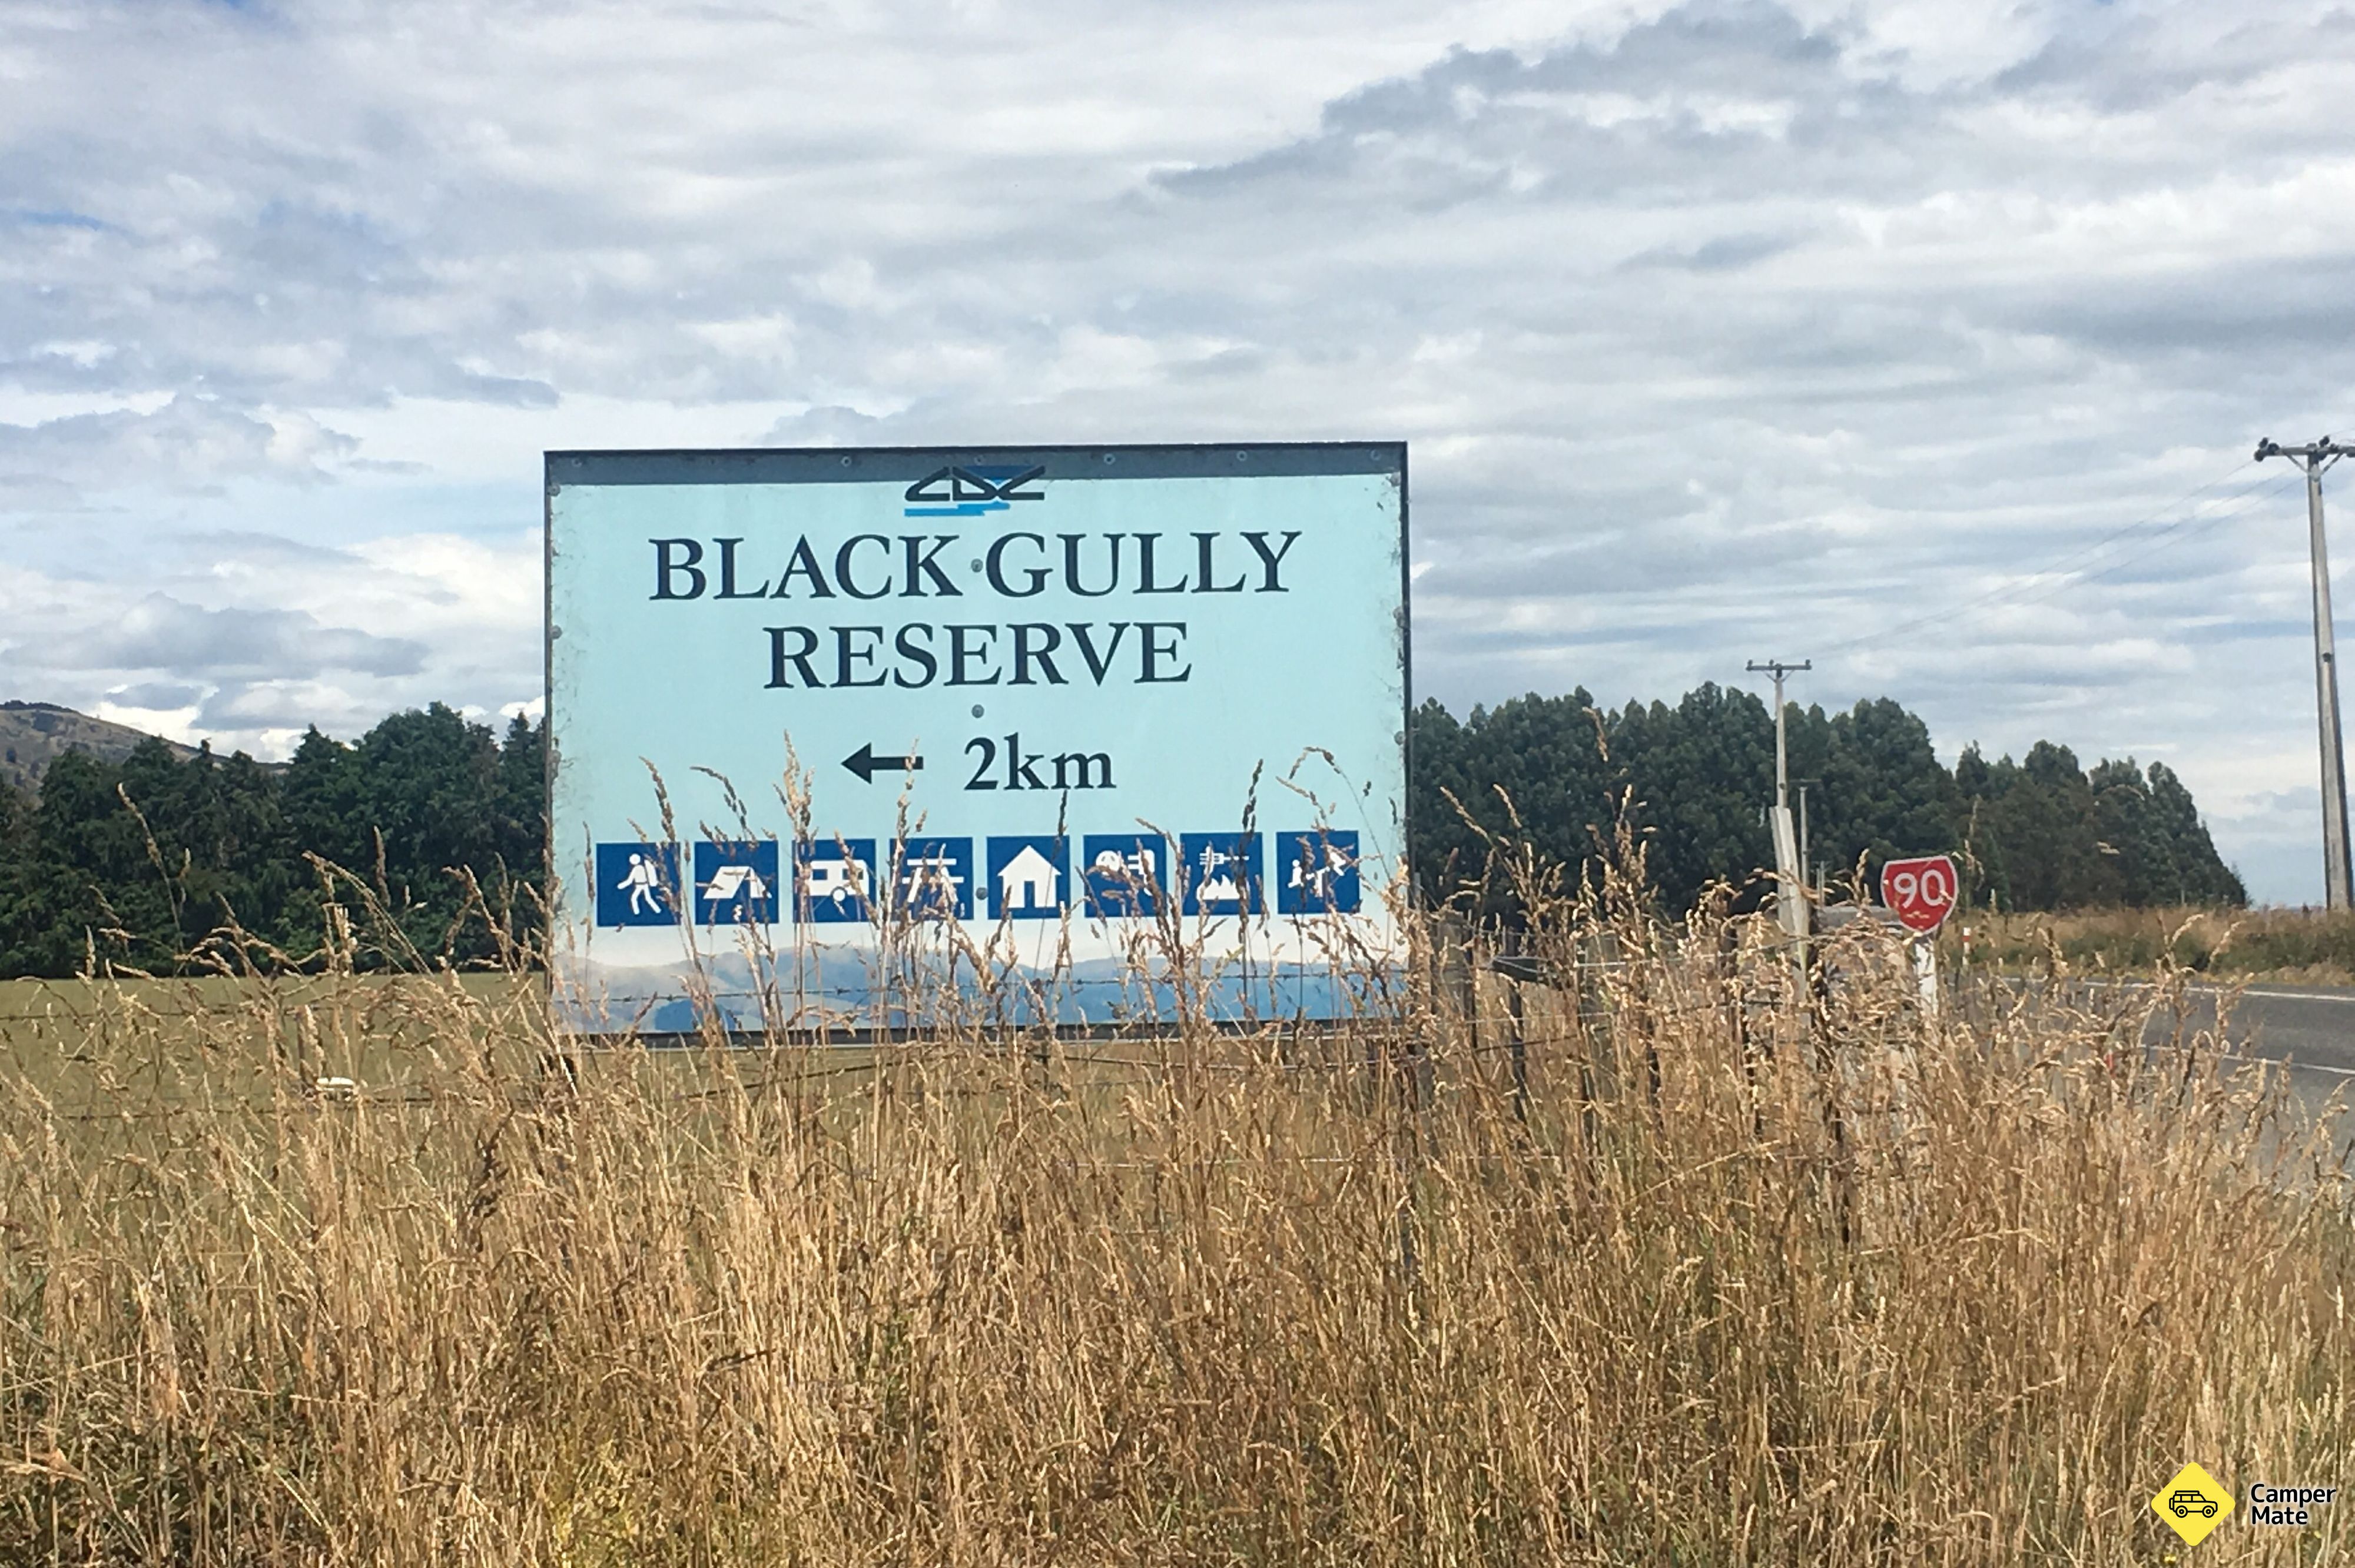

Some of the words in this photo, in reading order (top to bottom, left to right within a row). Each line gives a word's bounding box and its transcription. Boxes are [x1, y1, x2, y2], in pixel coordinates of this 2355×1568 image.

[649, 534, 963, 600] BLACK
[986, 531, 1302, 597] GULLY
[763, 622, 1192, 689] RESERVE
[964, 732, 1117, 791] 2km
[1893, 869, 1946, 908] 90
